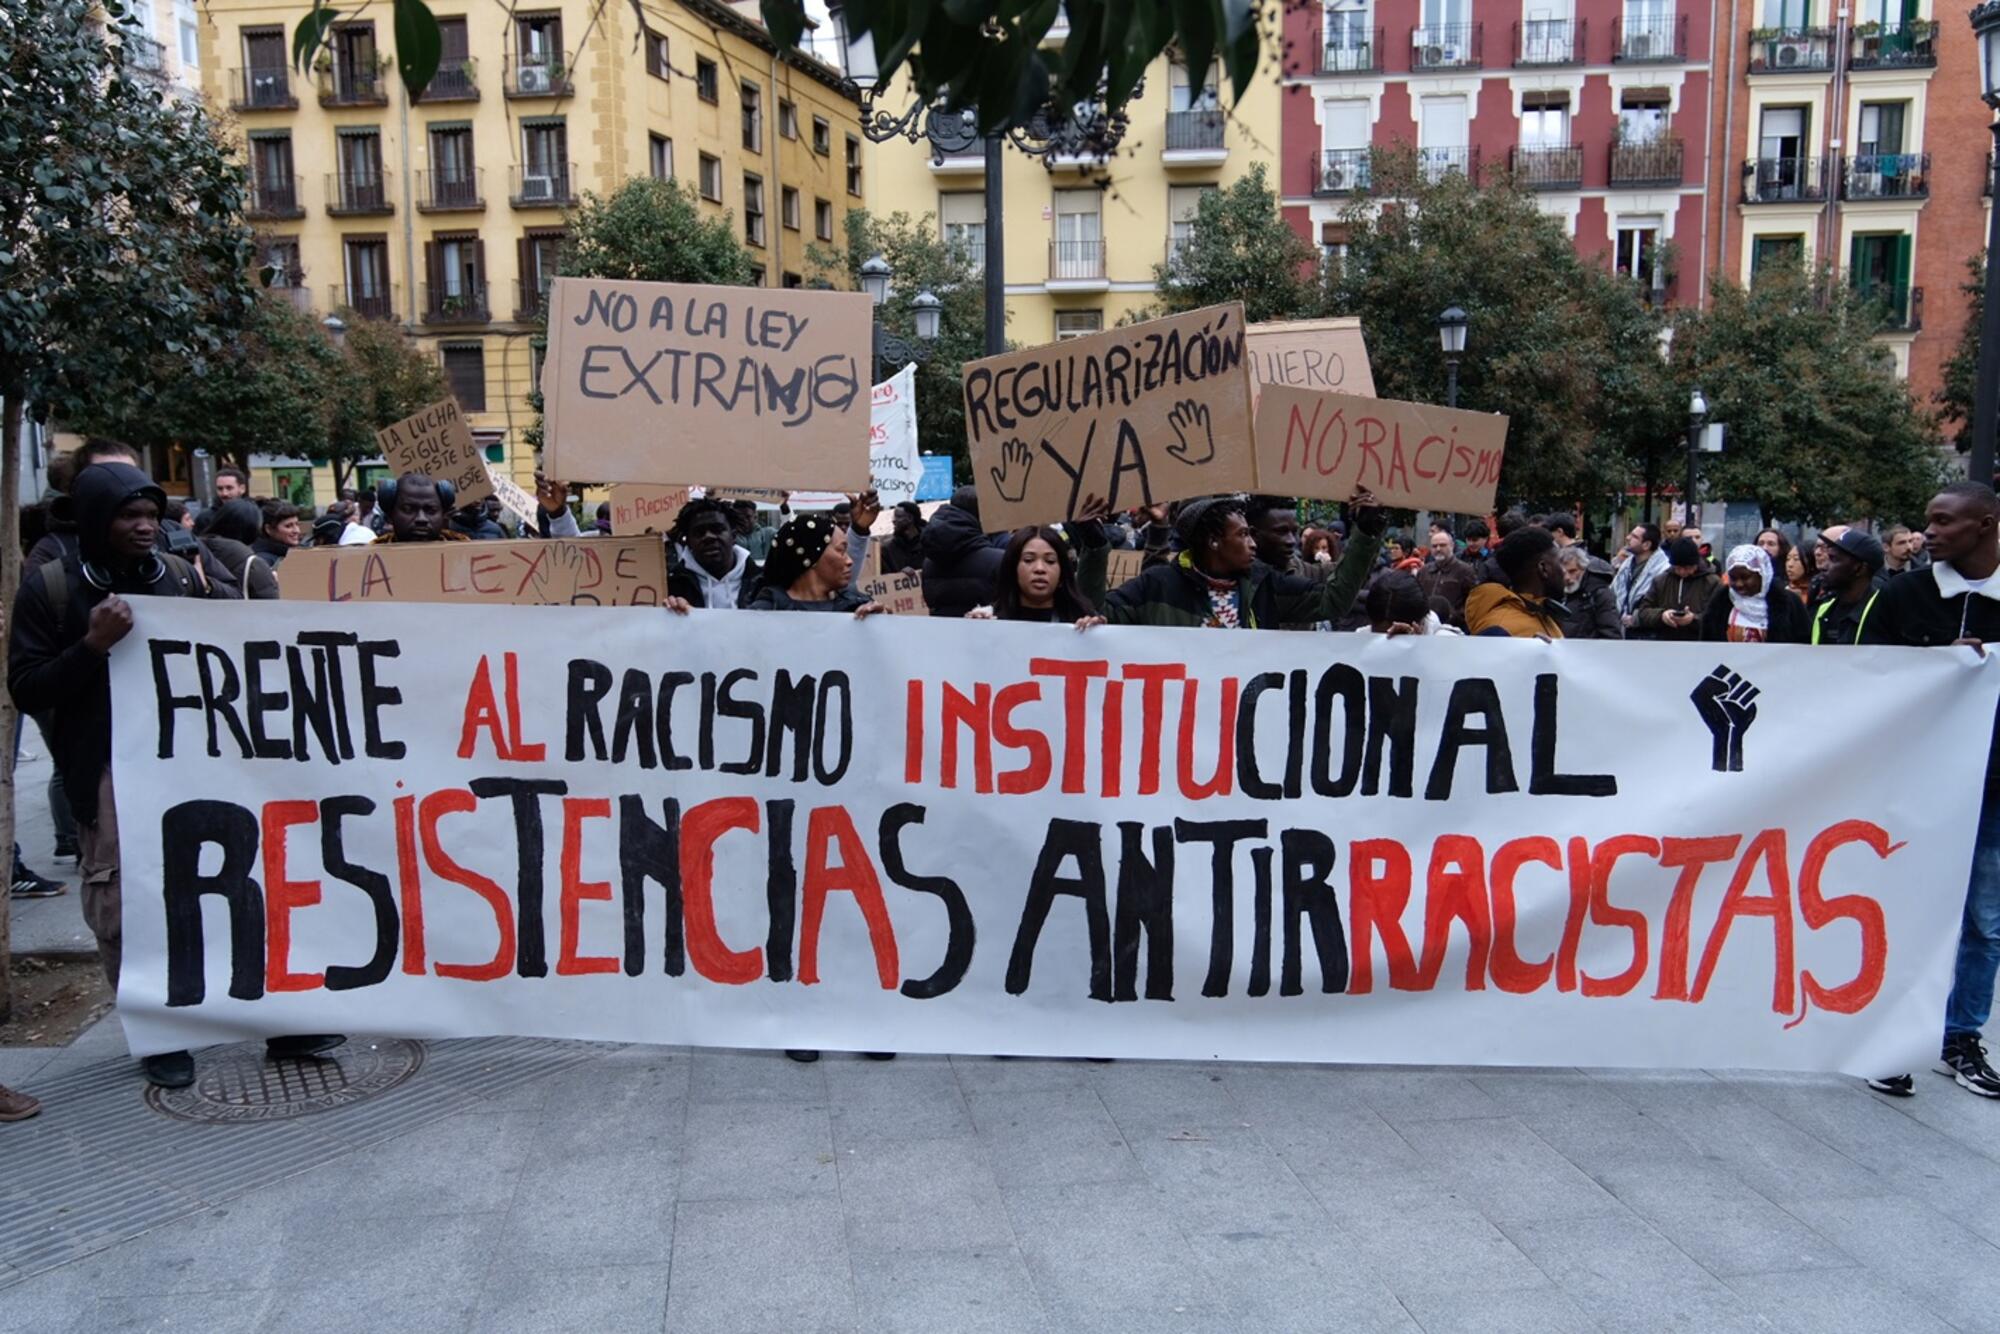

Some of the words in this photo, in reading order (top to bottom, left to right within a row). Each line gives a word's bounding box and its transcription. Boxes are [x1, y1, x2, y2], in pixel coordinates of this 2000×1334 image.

[574, 289, 637, 333] NO
[650, 296, 673, 331] A
[685, 299, 727, 338] LA
[745, 306, 809, 352] LEY
[1249, 349, 1345, 386] UIERO
[381, 428, 403, 453] LA
[408, 403, 457, 439] LUCHA
[463, 444, 477, 458] LO
[1281, 398, 1347, 475] NO
[1041, 418, 1152, 521] YA
[328, 553, 393, 602] LA
[148, 631, 406, 765] FRENTE
[456, 651, 546, 762] AL
[564, 658, 853, 787] RACISMO
[904, 657, 1618, 801] INSTITUCIONAL
[1004, 816, 1906, 1029] ANTIRRACISTAS
